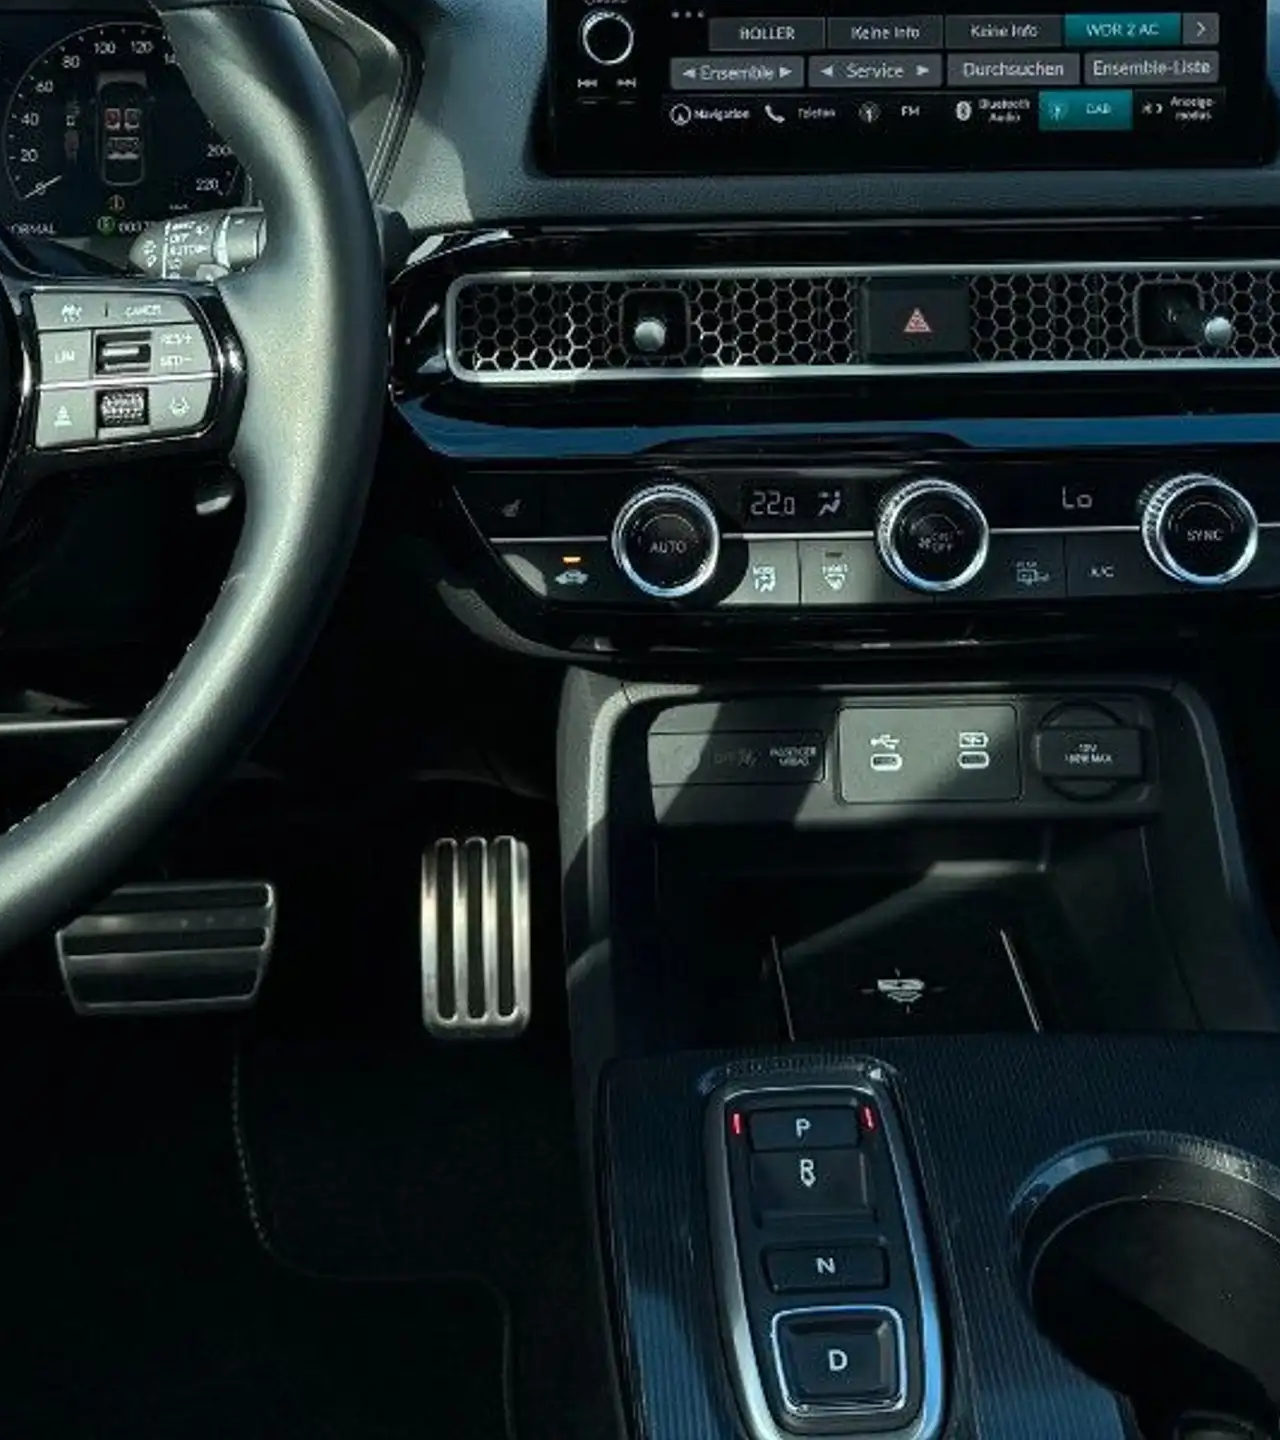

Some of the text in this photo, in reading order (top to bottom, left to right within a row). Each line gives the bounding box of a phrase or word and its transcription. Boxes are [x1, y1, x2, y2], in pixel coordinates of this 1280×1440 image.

[850, 26, 921, 41] Keine Info
[970, 23, 1039, 38] Keine Info
[1086, 23, 1160, 37] WDR 2 AC
[93, 42, 117, 55] 100
[131, 41, 153, 55] 120
[61, 55, 80, 70] 80
[963, 61, 1064, 77] Durchsuchen
[1093, 59, 1213, 77] Ensemble-Liste
[700, 64, 775, 81] Ensemble
[846, 62, 904, 79] Service
[901, 105, 921, 118] FM
[21, 112, 40, 127] 40
[20, 148, 39, 163] 20
[195, 178, 219, 191] 220
[1061, 485, 1093, 510] Lo
[1186, 527, 1224, 543] SYNC
[649, 540, 687, 554] AUTO
[1089, 565, 1115, 579] A/C
[795, 1119, 812, 1139] P
[816, 1258, 836, 1275] N
[828, 1350, 849, 1372] D
